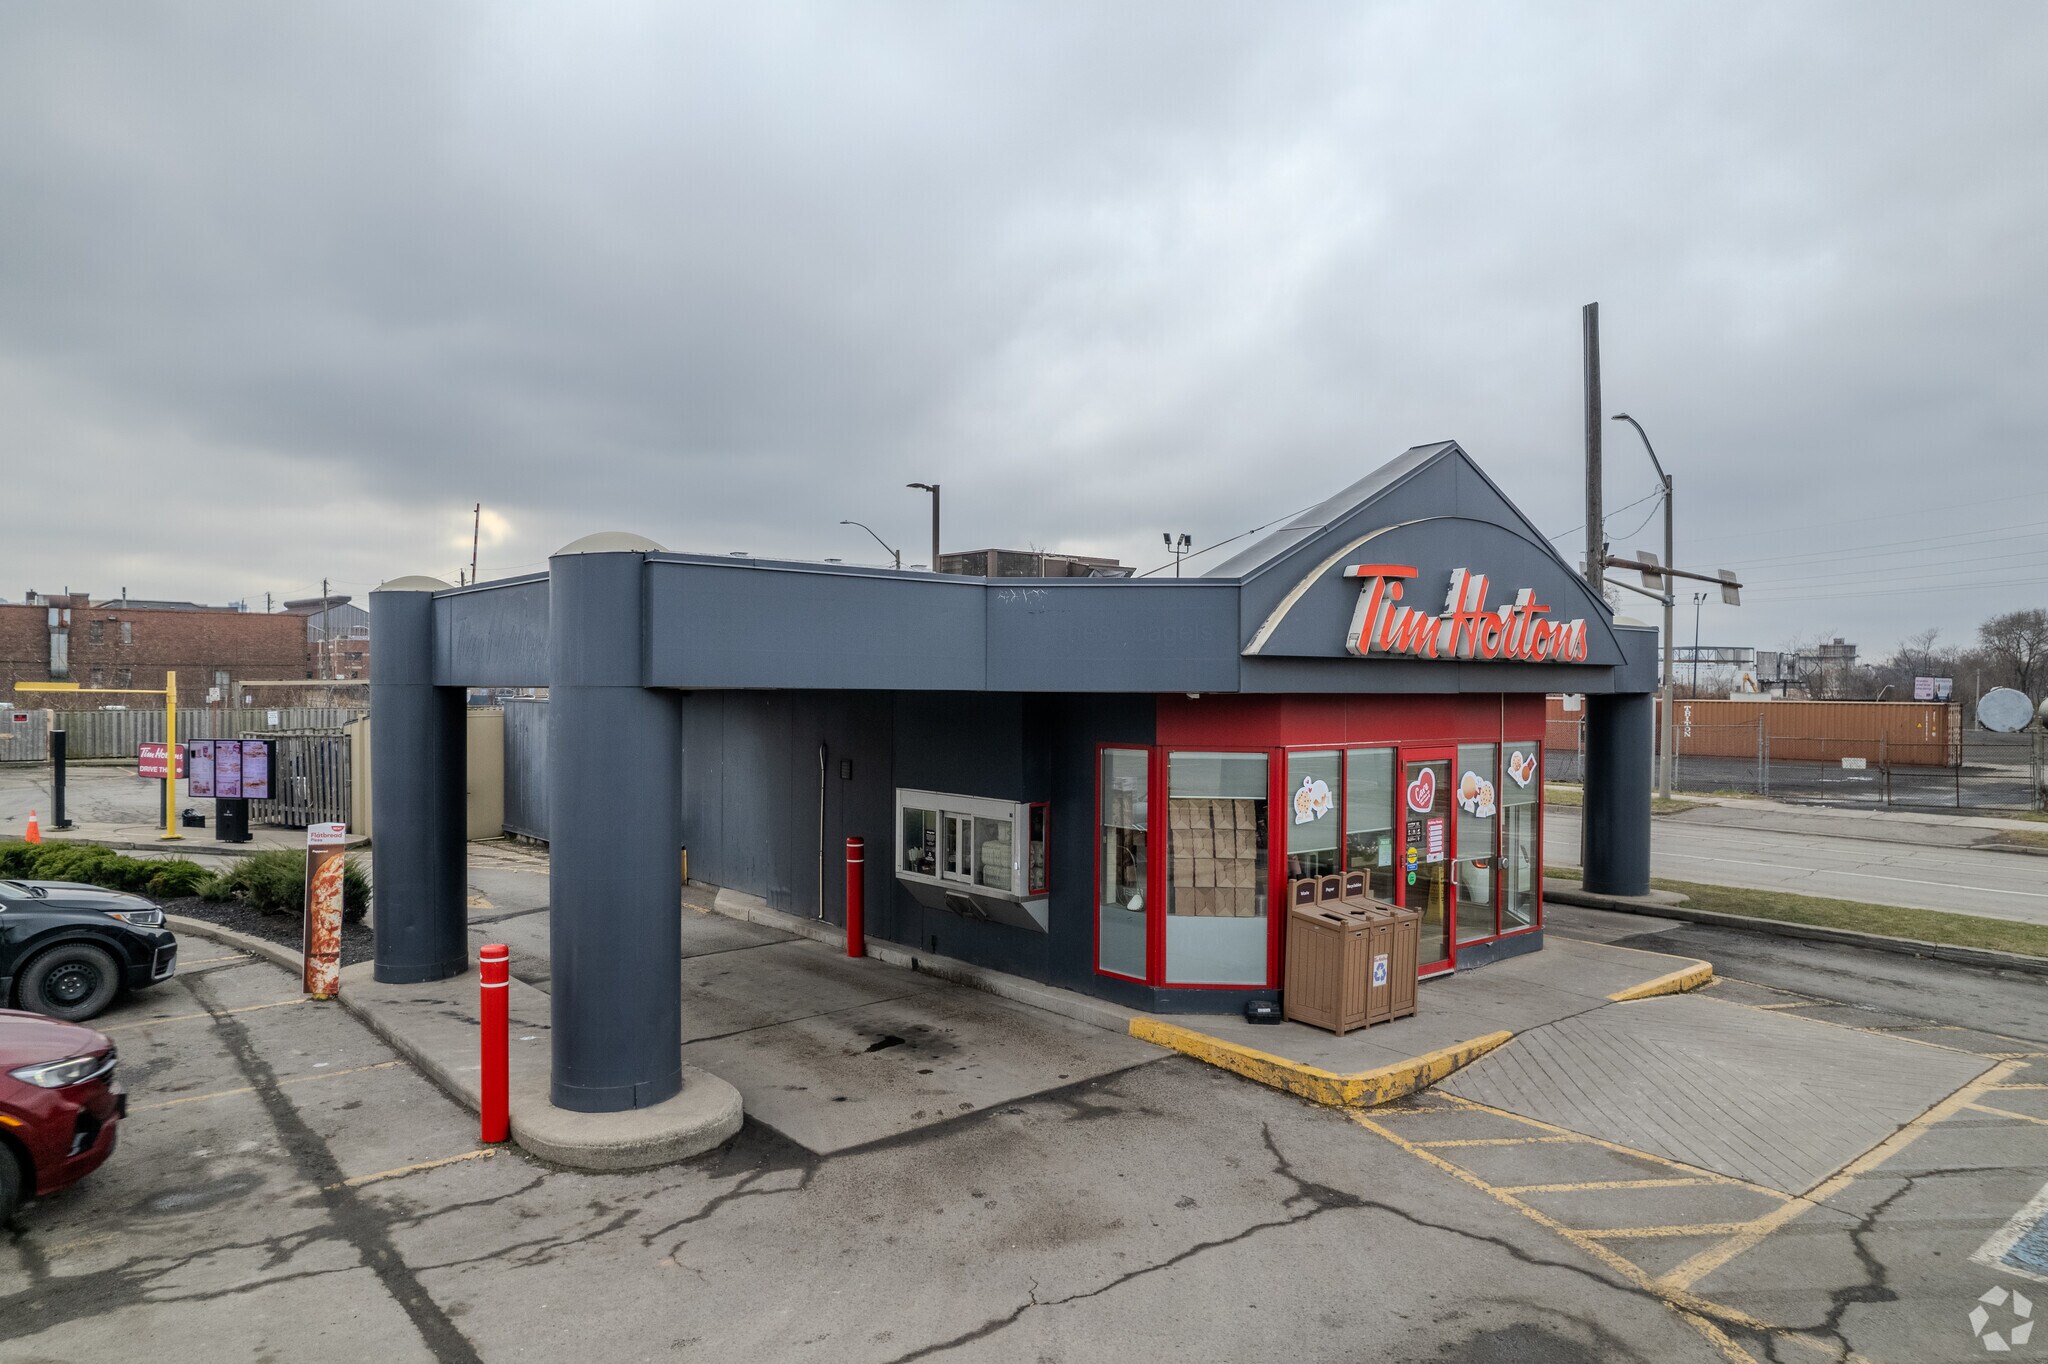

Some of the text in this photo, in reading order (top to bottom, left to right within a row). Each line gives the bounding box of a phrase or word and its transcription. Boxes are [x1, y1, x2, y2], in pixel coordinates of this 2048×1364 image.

[1347, 564, 1588, 662] Tim Hortons
[1684, 705, 1692, 737] TRITON
[140, 747, 155, 759] Tim
[139, 765, 158, 773] DRIVE
